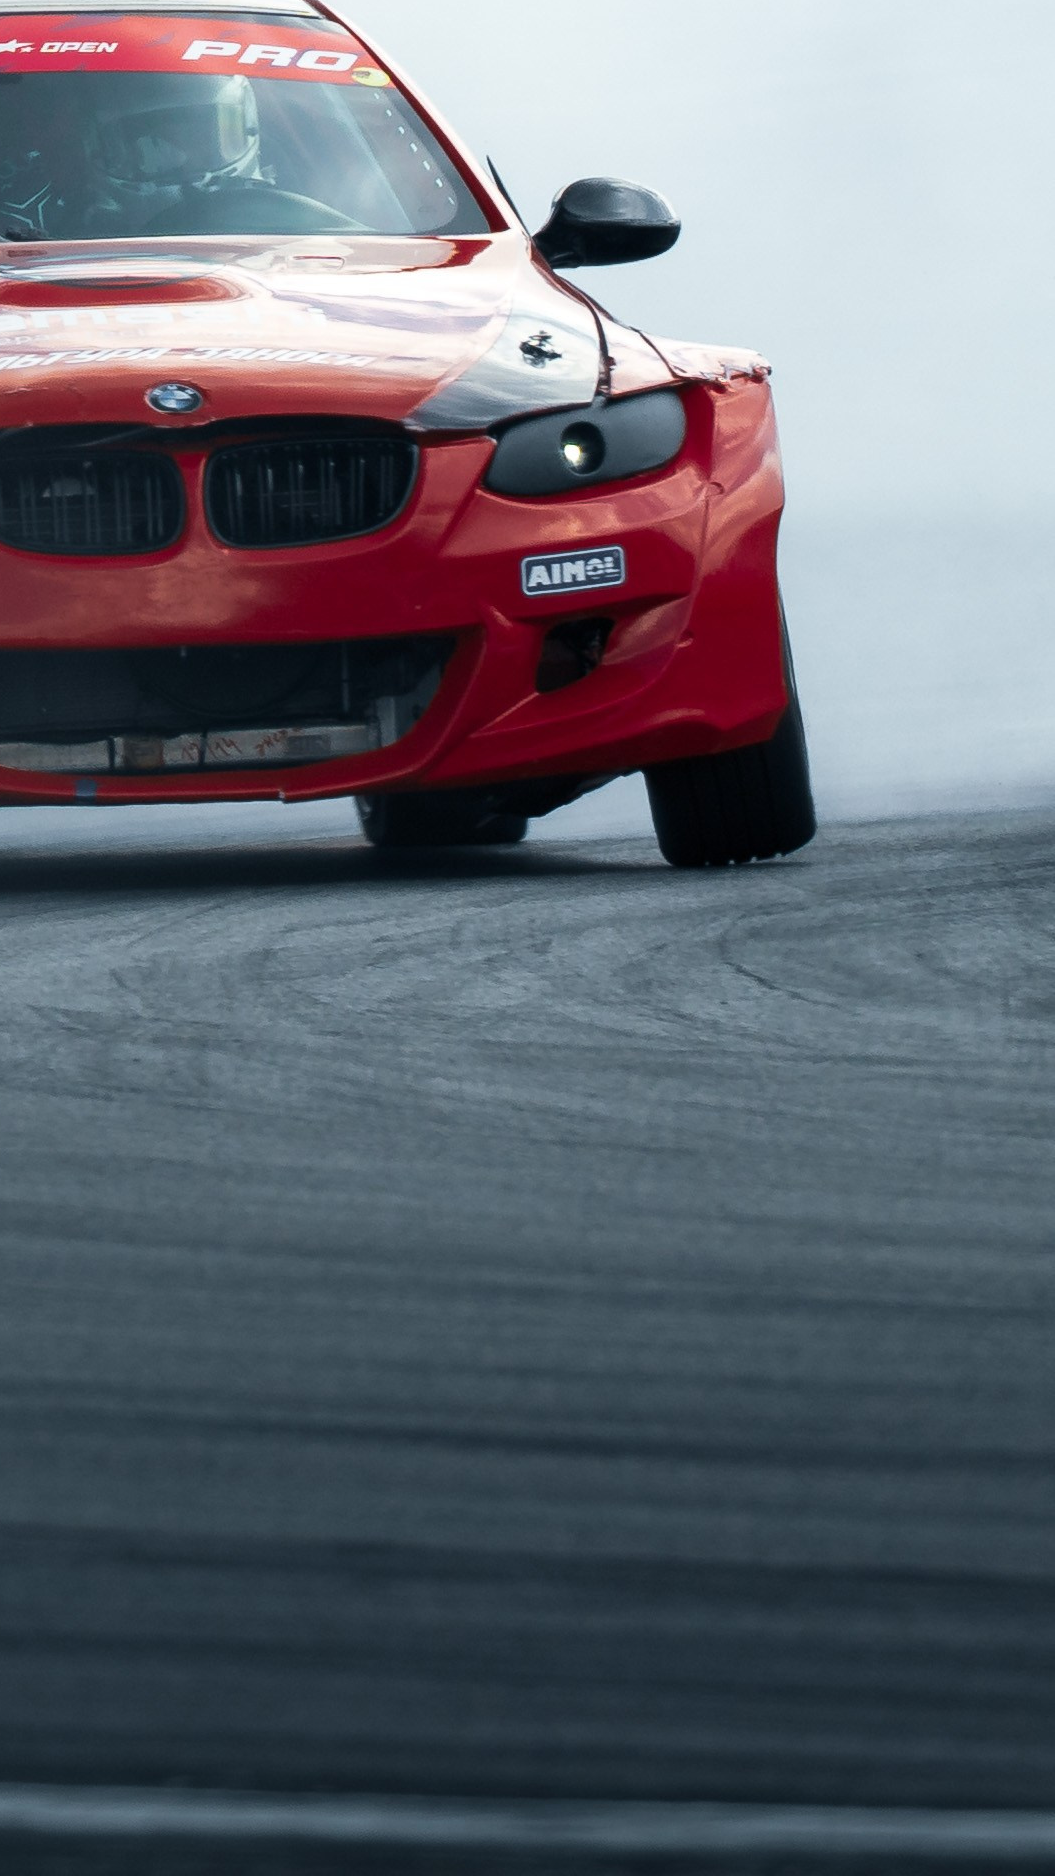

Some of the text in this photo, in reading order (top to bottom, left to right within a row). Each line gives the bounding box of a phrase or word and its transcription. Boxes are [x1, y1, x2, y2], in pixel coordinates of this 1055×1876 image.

[39, 41, 119, 54] OPEN
[181, 39, 359, 72] PRO
[527, 556, 620, 588] AIMOL
